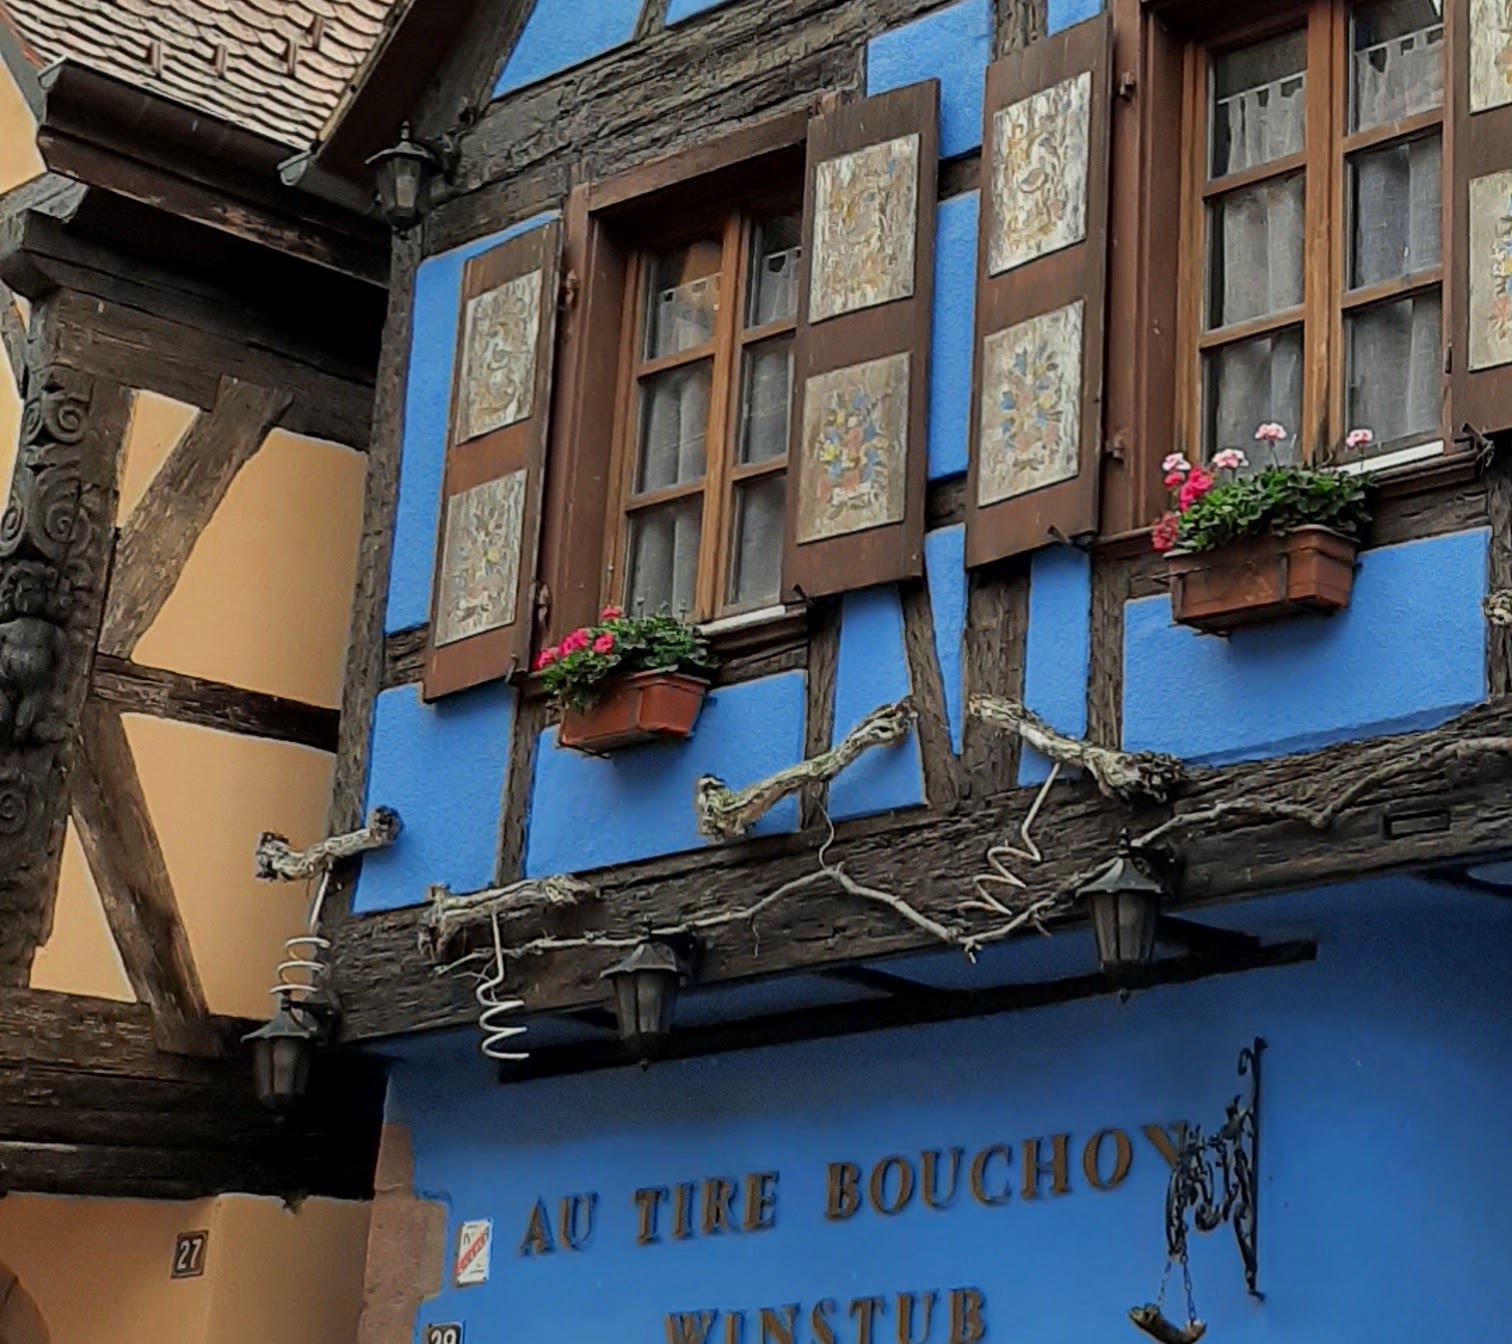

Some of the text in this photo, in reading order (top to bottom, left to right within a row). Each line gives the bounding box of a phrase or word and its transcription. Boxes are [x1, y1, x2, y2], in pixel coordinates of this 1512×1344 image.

[519, 1193, 599, 1256] AU
[631, 1170, 780, 1246] TIRE
[177, 1238, 202, 1269] 27
